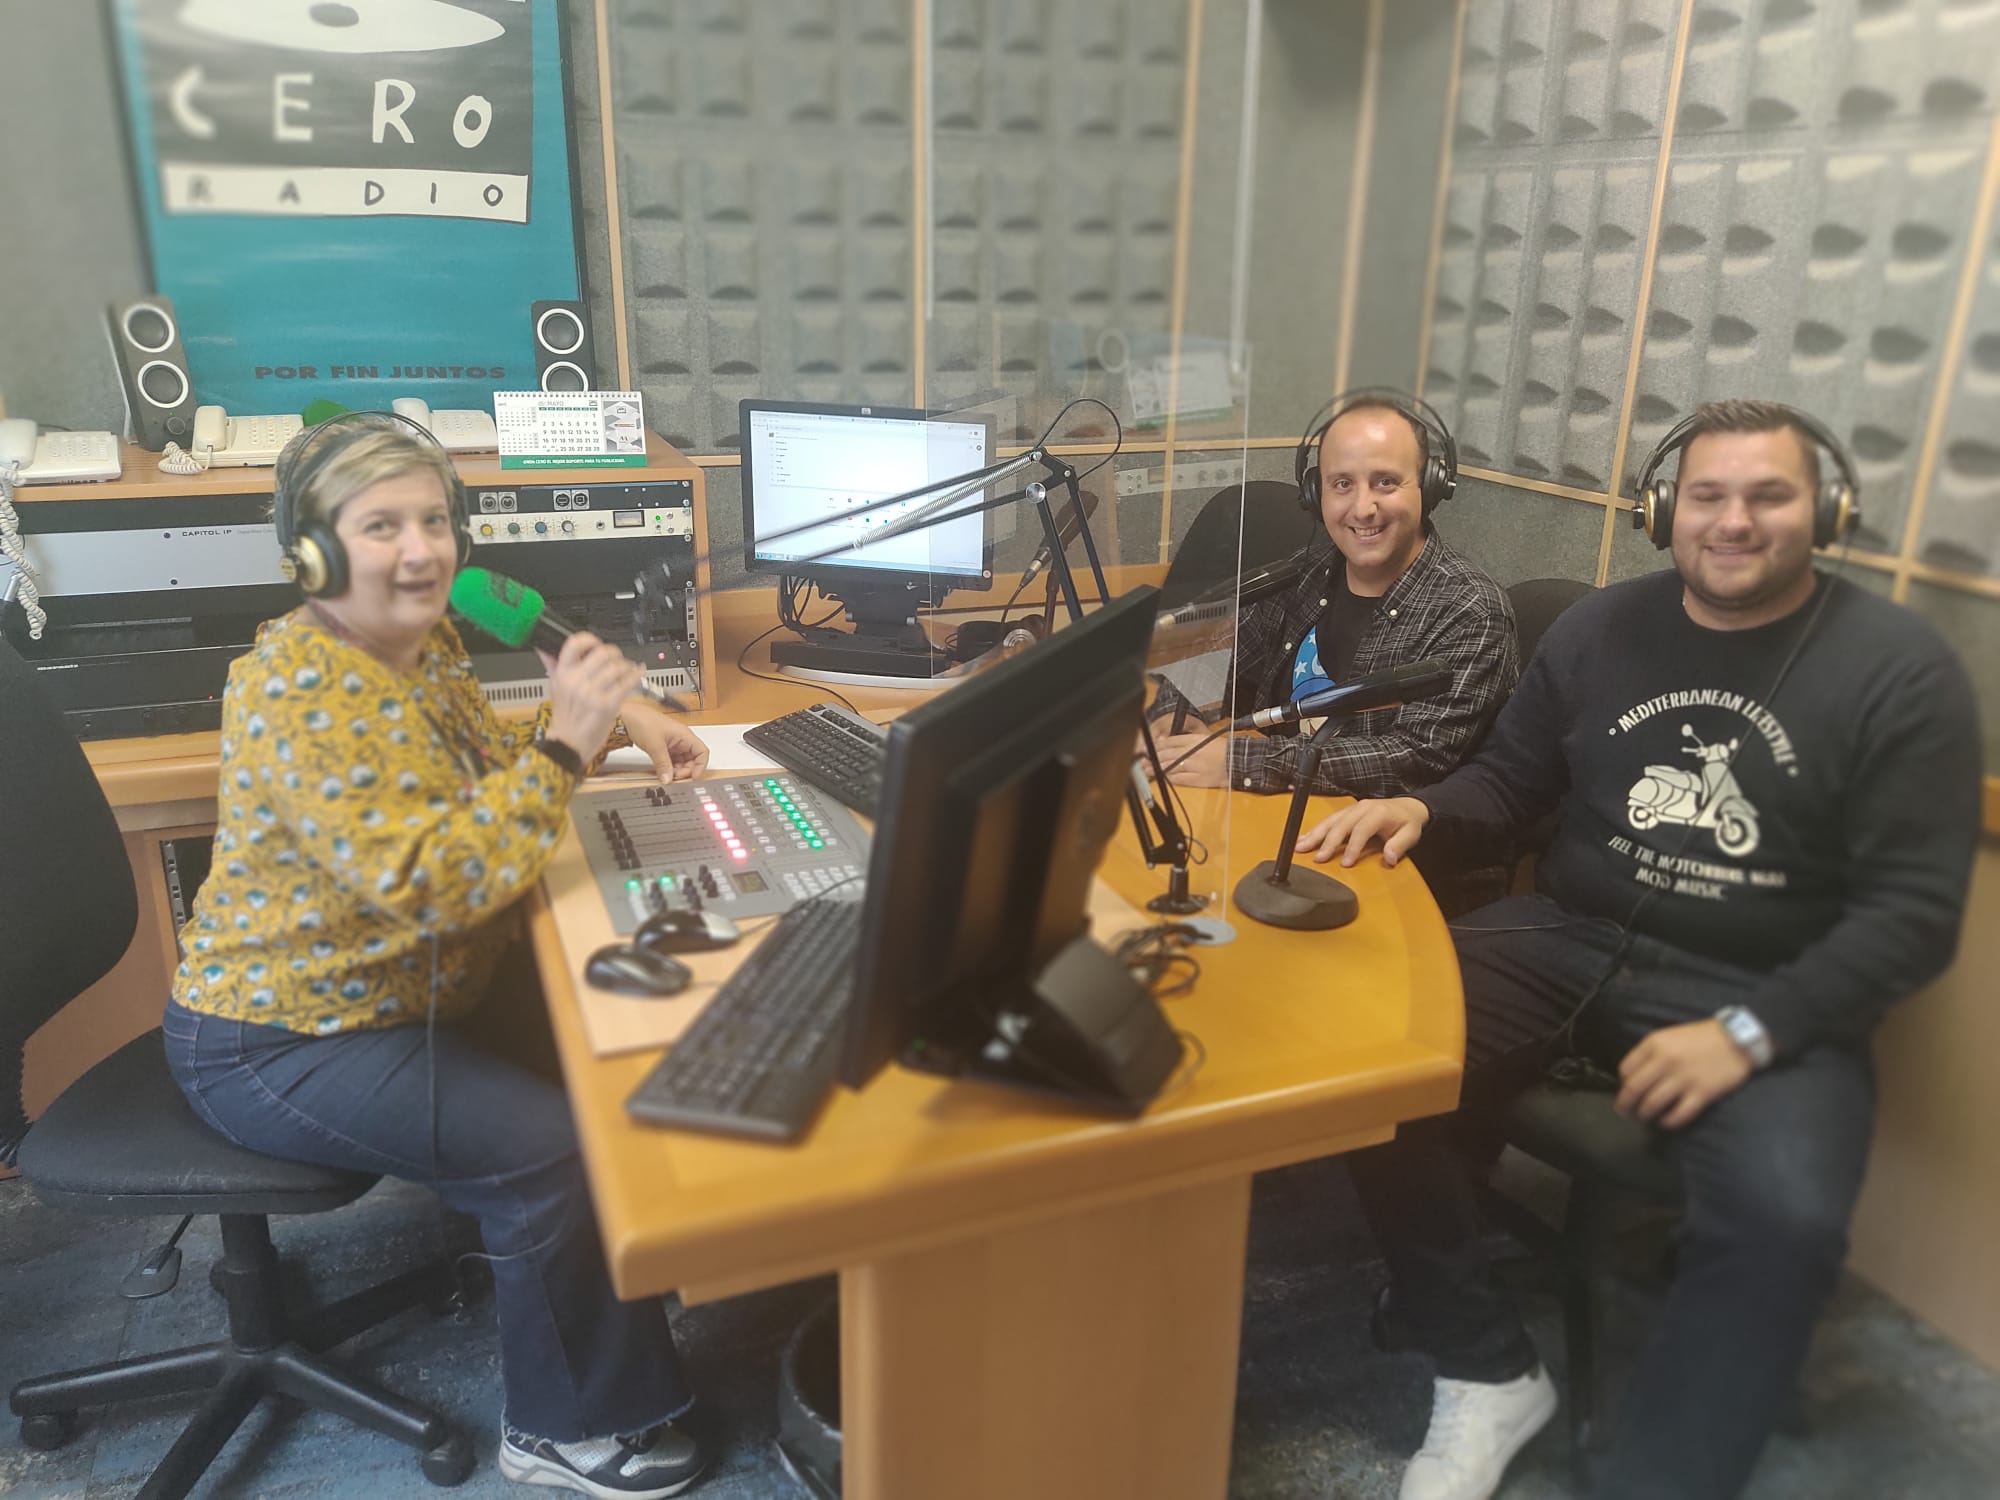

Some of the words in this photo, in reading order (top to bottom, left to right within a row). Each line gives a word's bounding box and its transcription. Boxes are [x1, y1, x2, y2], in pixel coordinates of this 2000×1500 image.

[169, 65, 493, 149] CERO
[187, 174, 504, 207] RADIO
[254, 365, 318, 380] POR
[330, 365, 379, 379] FIN
[388, 365, 506, 380] JUNTOS
[1617, 689, 1745, 733] MEDITERRANEAN
[1607, 835, 1633, 855] FEEL
[1634, 845, 1655, 865] THE
